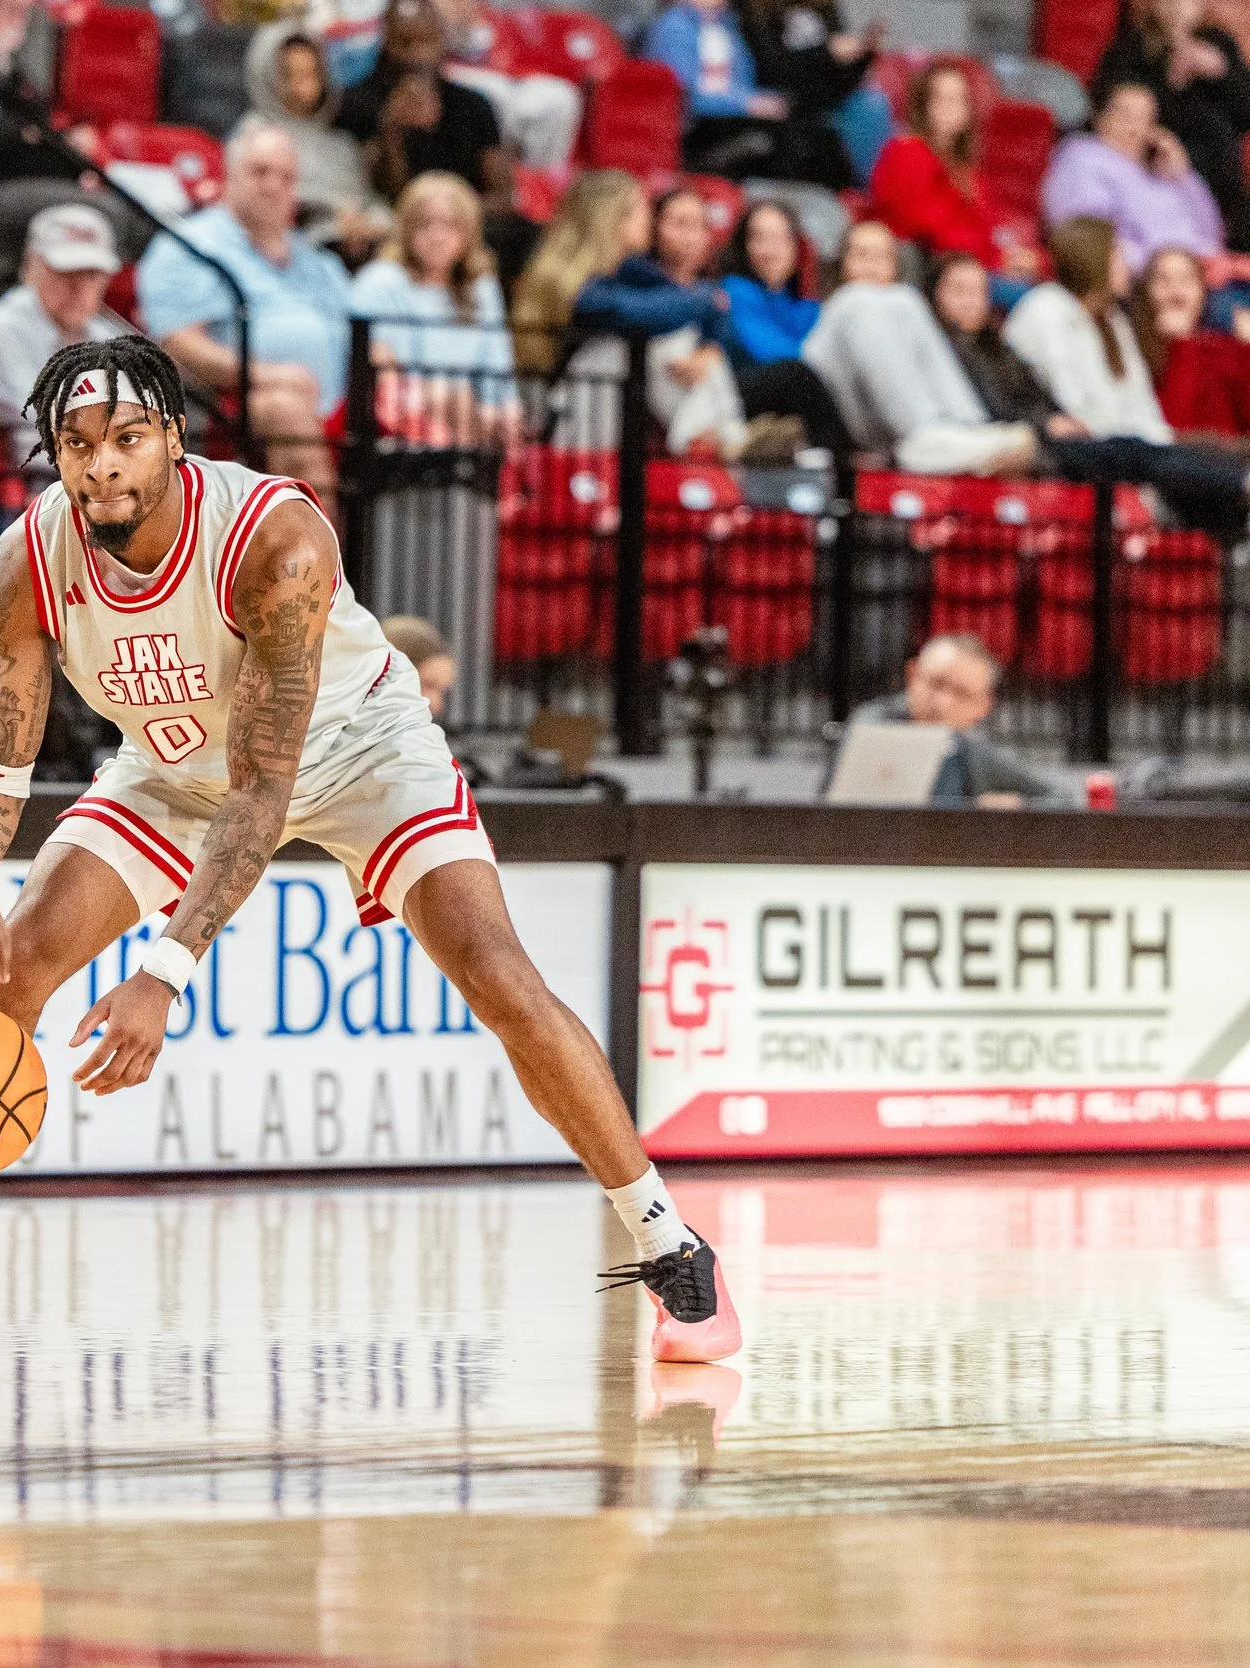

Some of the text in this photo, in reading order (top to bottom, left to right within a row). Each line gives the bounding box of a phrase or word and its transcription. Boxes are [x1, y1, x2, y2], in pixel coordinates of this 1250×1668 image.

[111, 633, 185, 673] JAX
[98, 664, 214, 706] STATE
[142, 714, 208, 765] 0
[265, 877, 478, 1037] Ban
[756, 906, 1172, 989] GILREATH
[1095, 1028, 1167, 1073] LLC
[153, 1068, 514, 1164] ALABAMA
